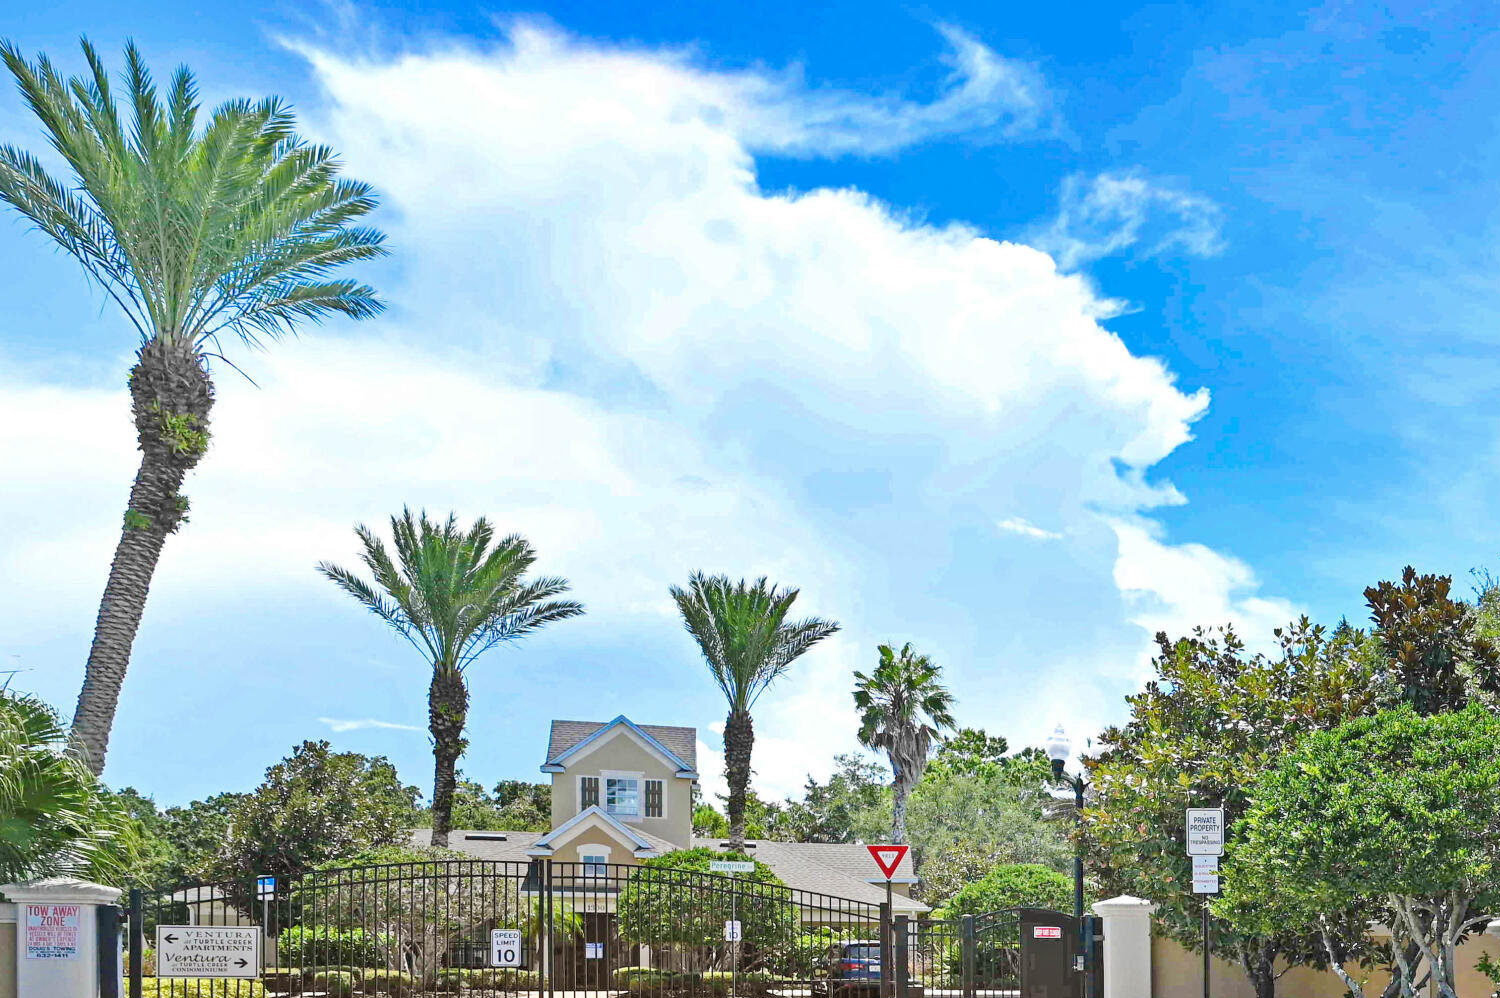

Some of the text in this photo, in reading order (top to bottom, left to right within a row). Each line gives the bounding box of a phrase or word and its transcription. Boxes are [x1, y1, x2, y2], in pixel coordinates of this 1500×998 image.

[1193, 816, 1217, 824] PRIVATE
[1190, 824, 1220, 832] PROPERTY
[711, 862, 746, 870] Peregrine
[29, 906, 77, 916] TOW AWAY
[41, 917, 65, 926] ZONE
[165, 952, 231, 962] Ventura
[497, 949, 515, 963] 10
